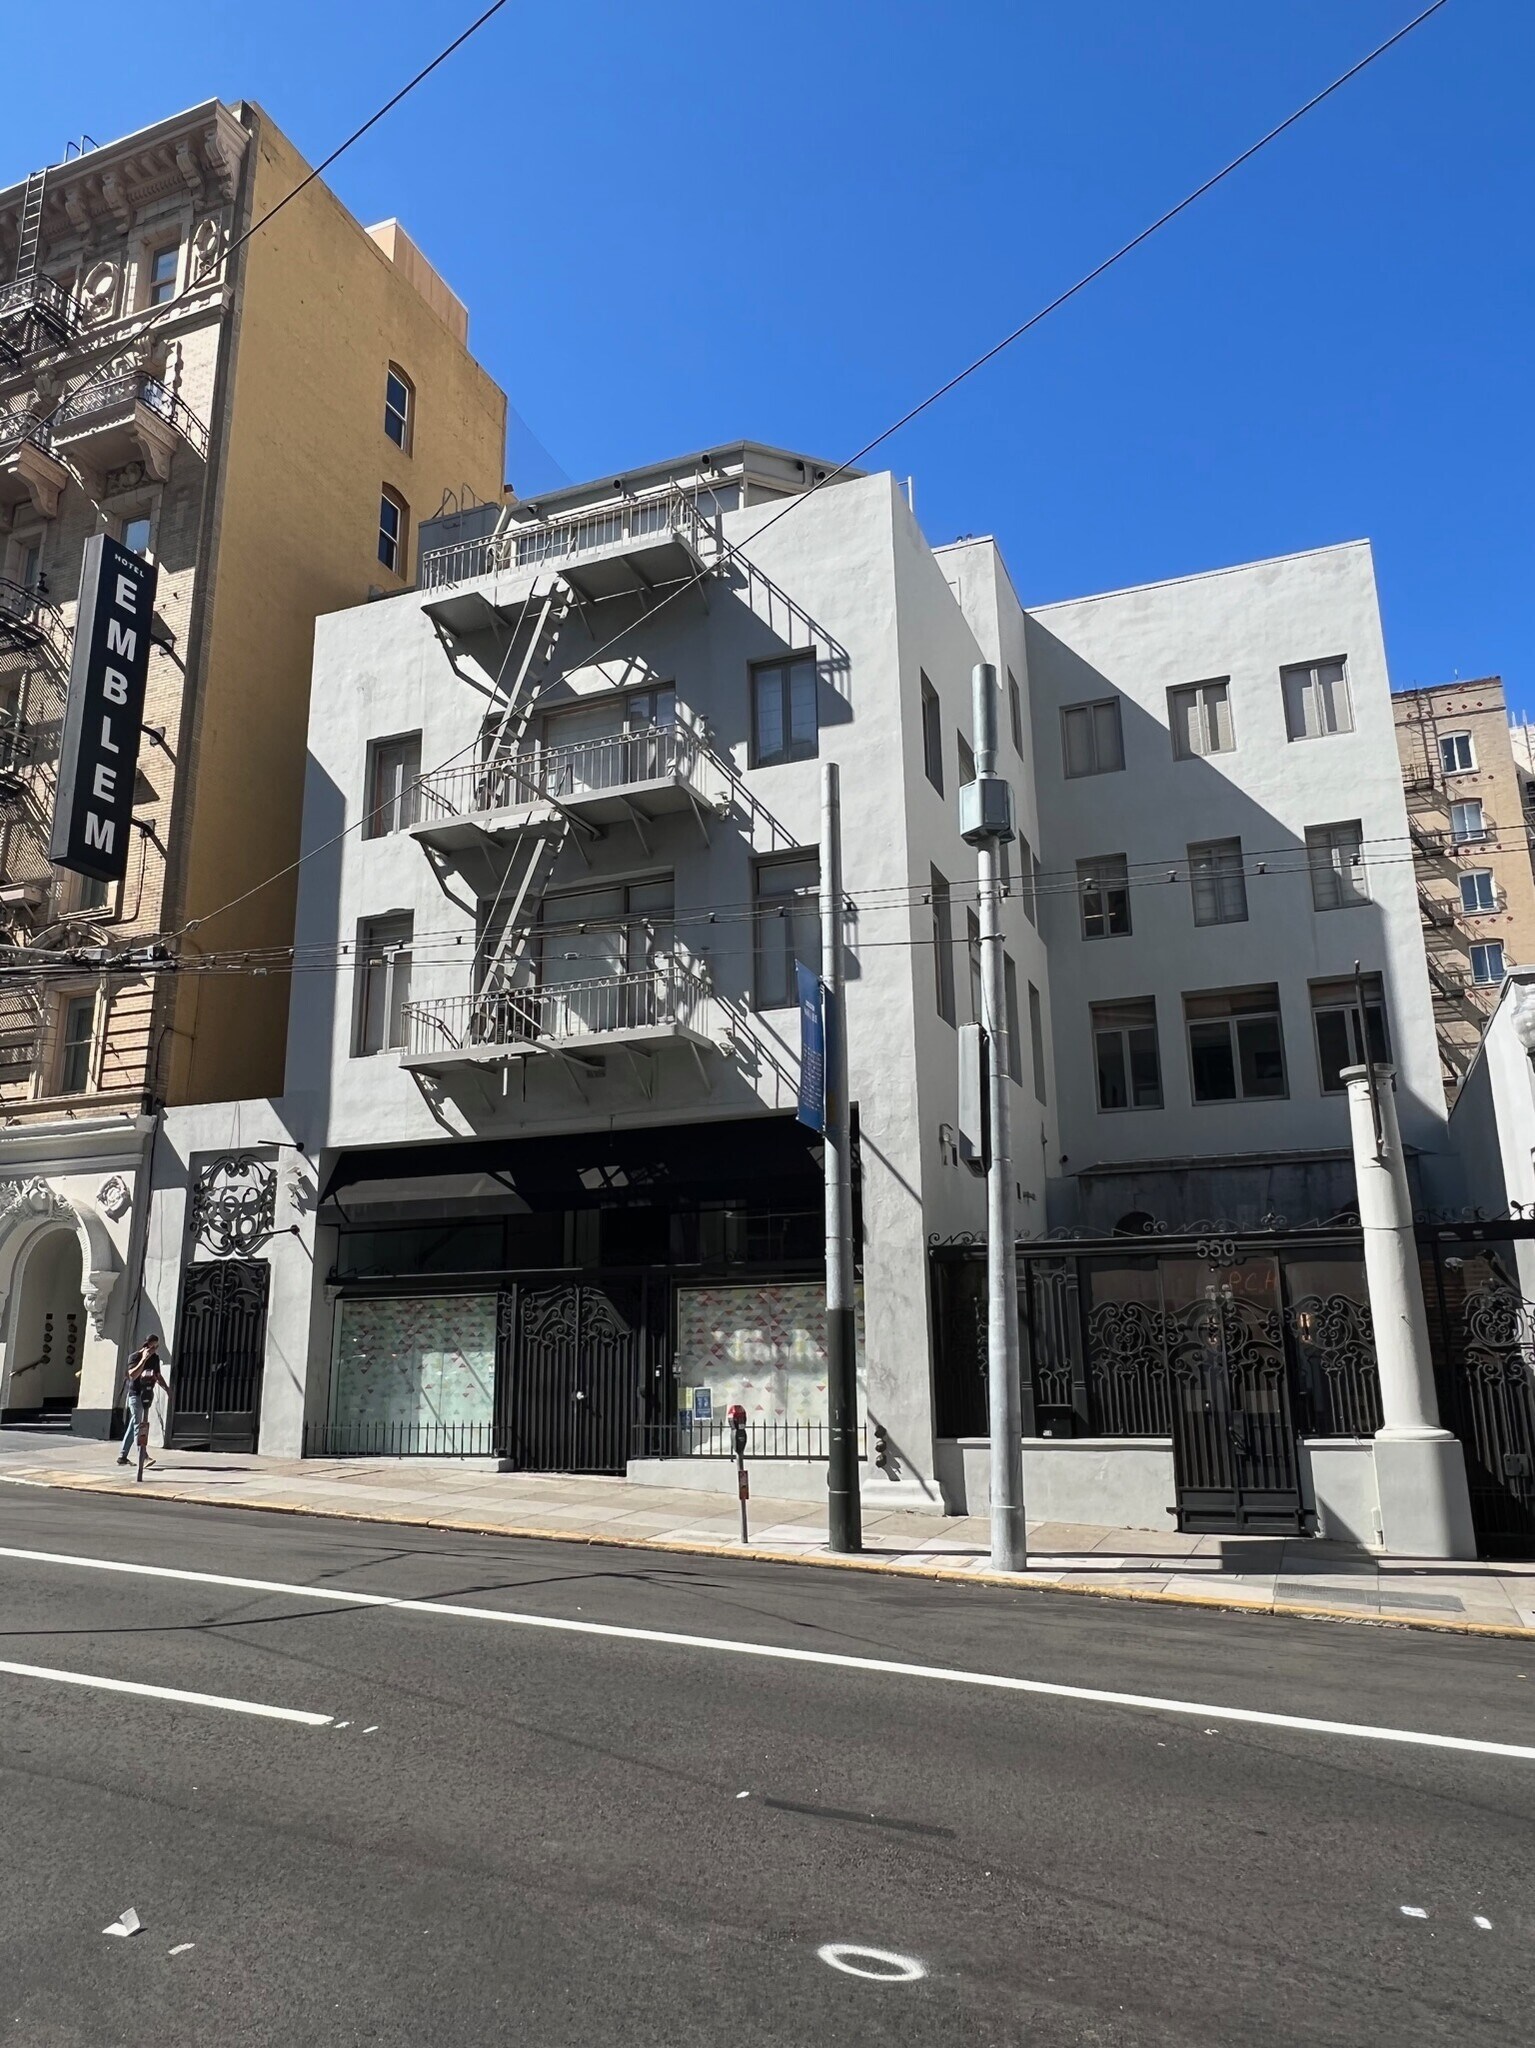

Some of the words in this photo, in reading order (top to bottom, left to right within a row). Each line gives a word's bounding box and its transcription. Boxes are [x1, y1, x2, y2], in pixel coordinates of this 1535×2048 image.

[114, 553, 144, 578] HOTEL
[84, 573, 138, 855] EMBLEM
[1196, 1239, 1236, 1258] 550
